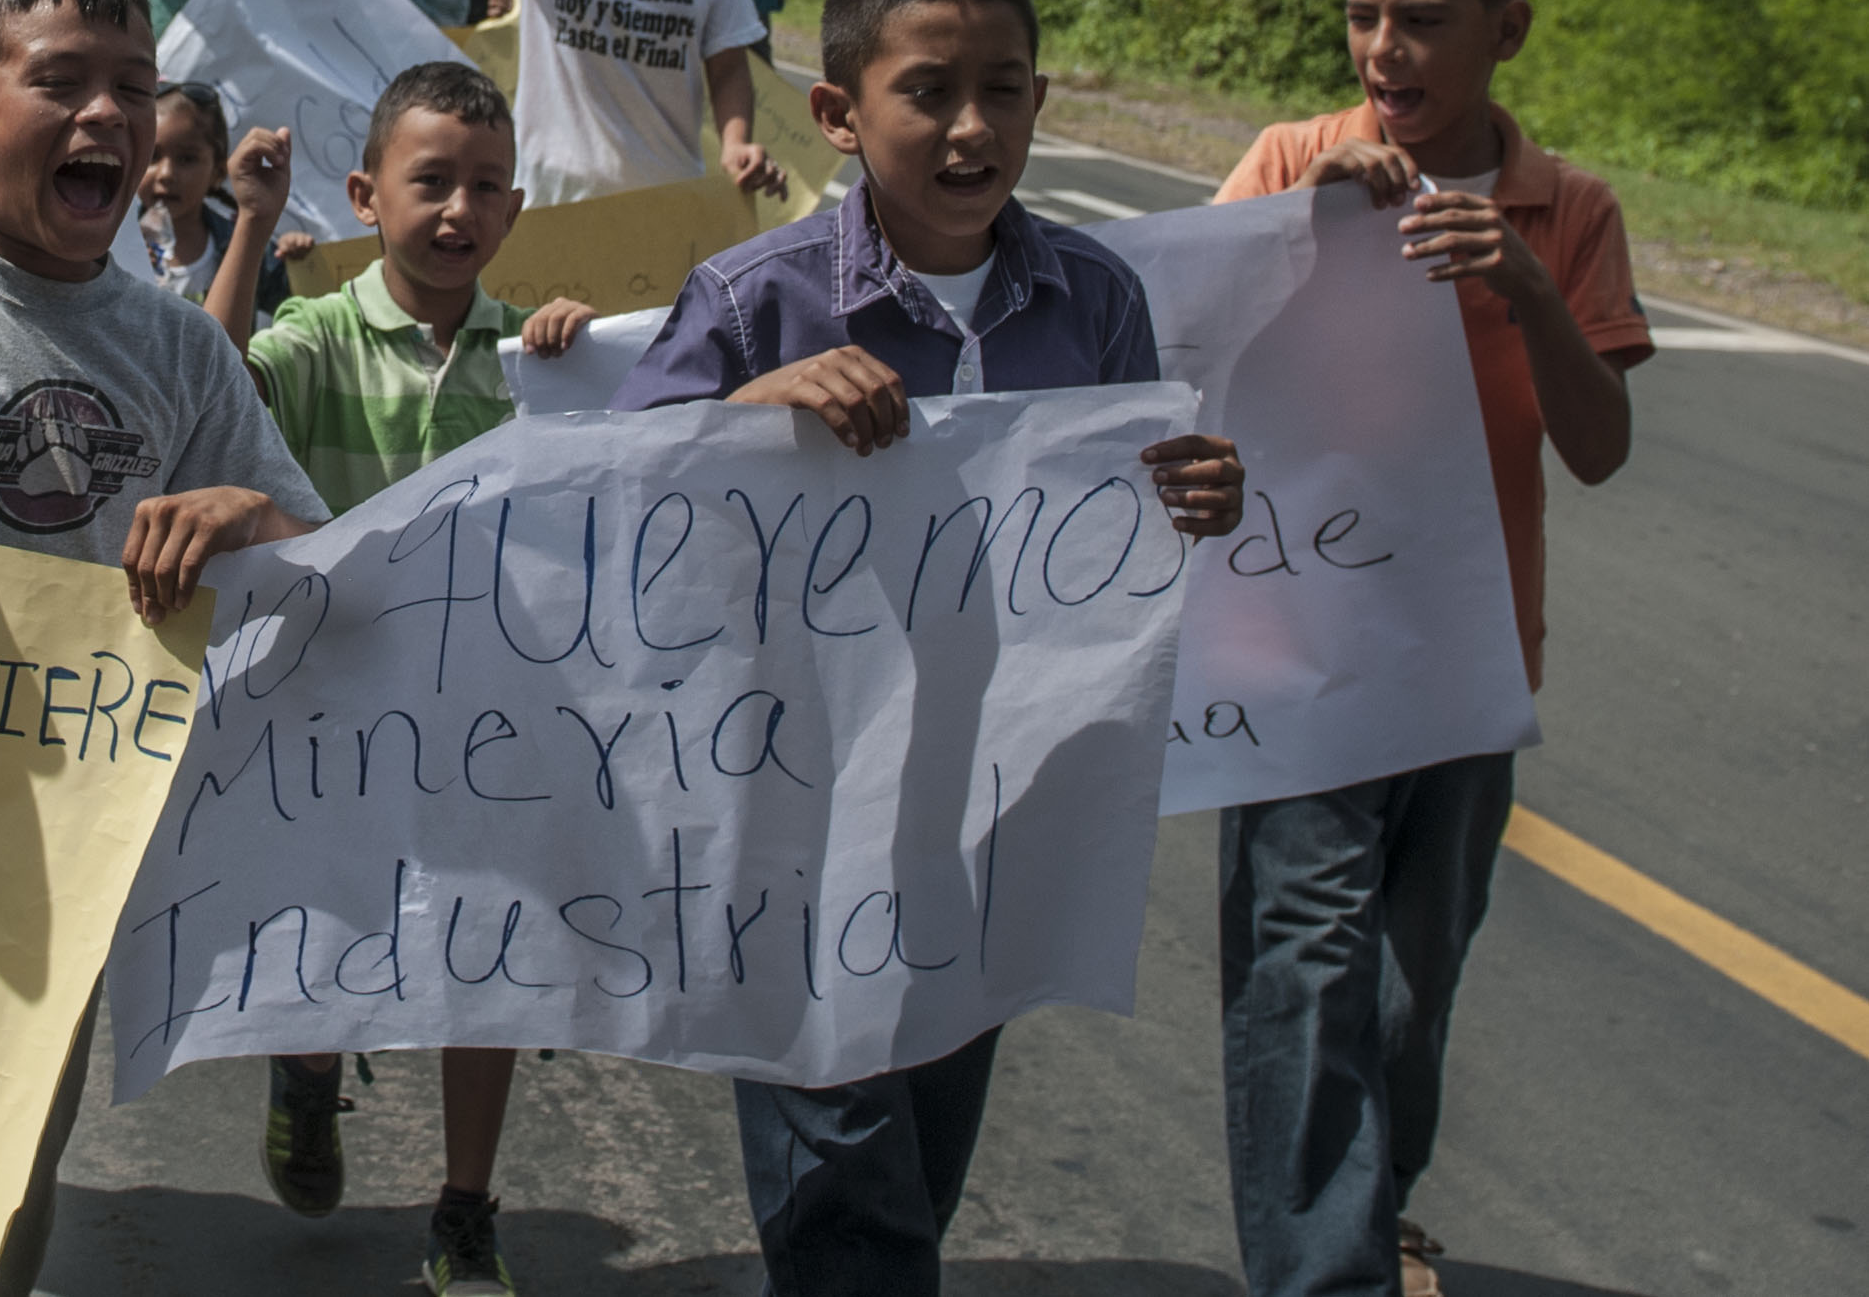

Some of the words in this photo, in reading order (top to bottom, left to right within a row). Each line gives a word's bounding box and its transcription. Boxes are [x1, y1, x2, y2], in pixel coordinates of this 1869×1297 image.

[593, 0, 610, 28] y
[612, 0, 696, 41] Siempre
[612, 35, 630, 61] el
[633, 37, 688, 71] Final
[1227, 490, 1394, 578] de
[129, 764, 1003, 1062] Industrial
